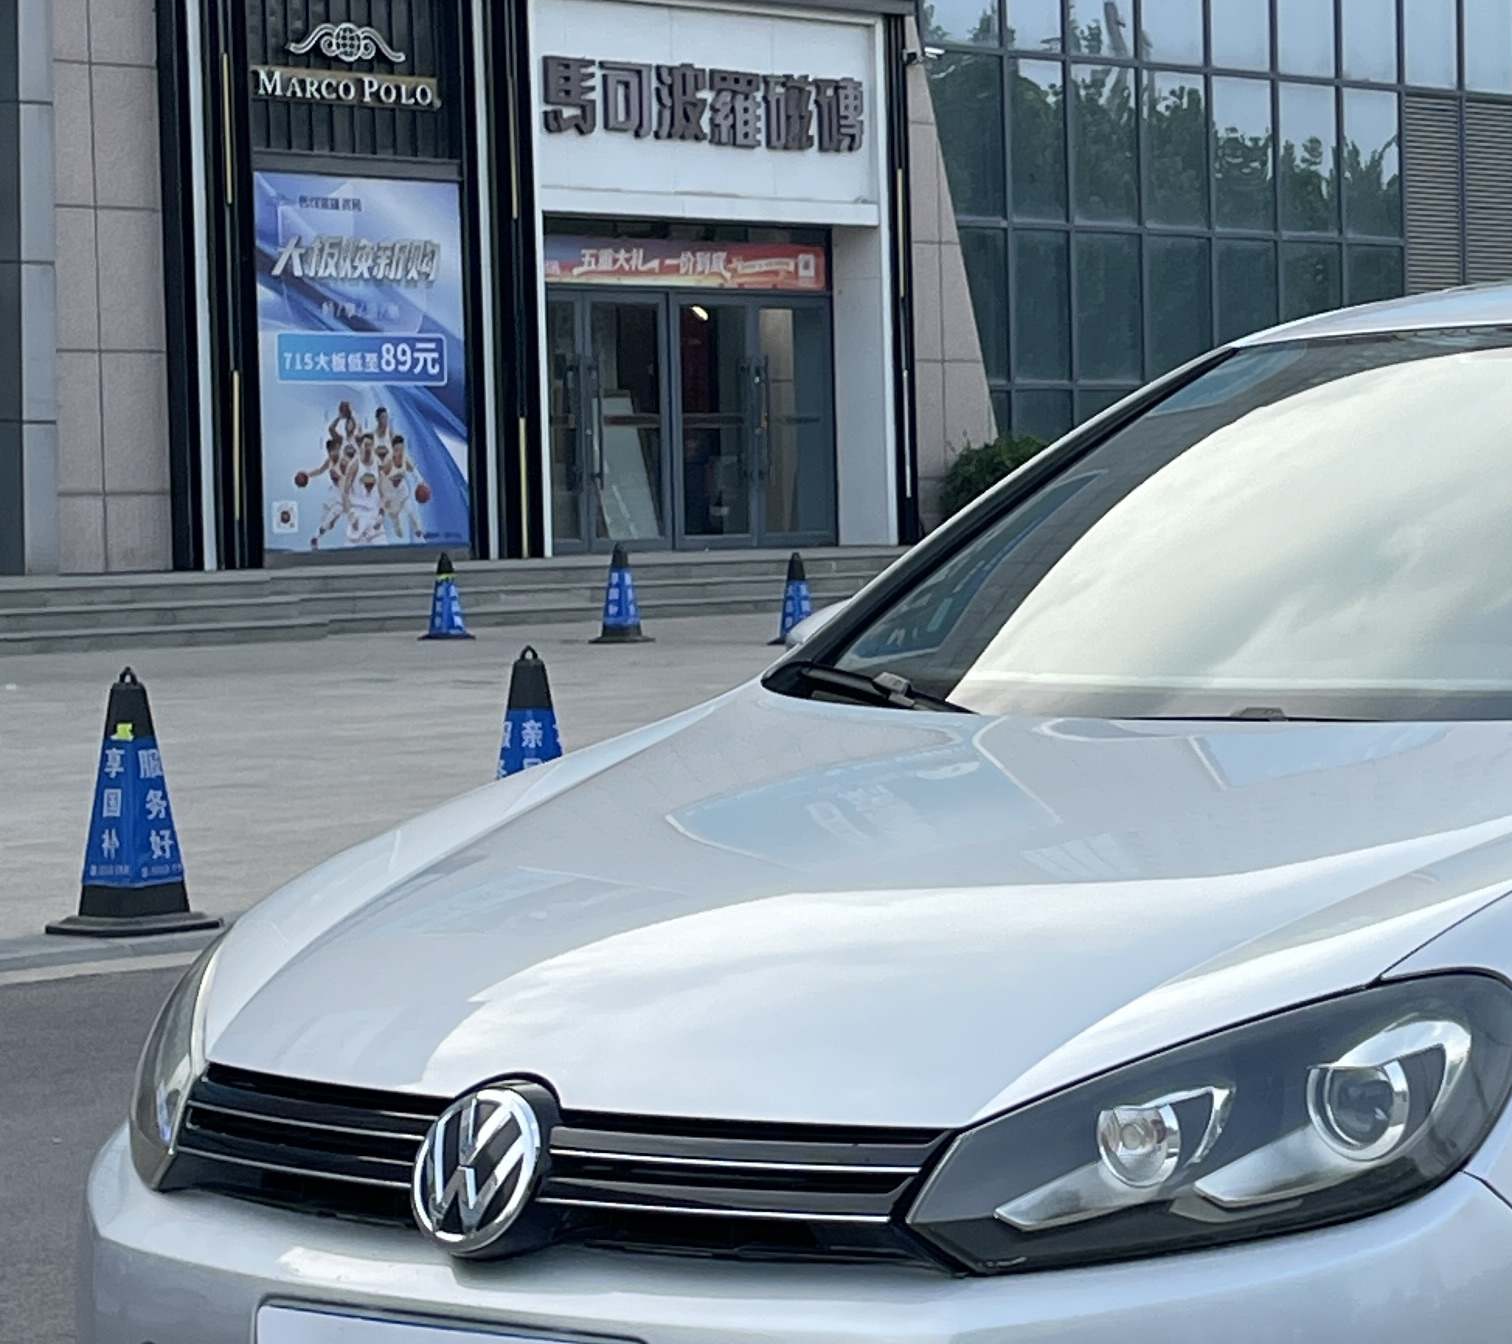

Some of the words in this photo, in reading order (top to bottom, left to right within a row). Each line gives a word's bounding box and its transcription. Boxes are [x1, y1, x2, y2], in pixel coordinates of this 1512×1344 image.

[257, 68, 357, 102] MARCO
[362, 76, 433, 107] POLO
[138, 748, 174, 859] 服务好
